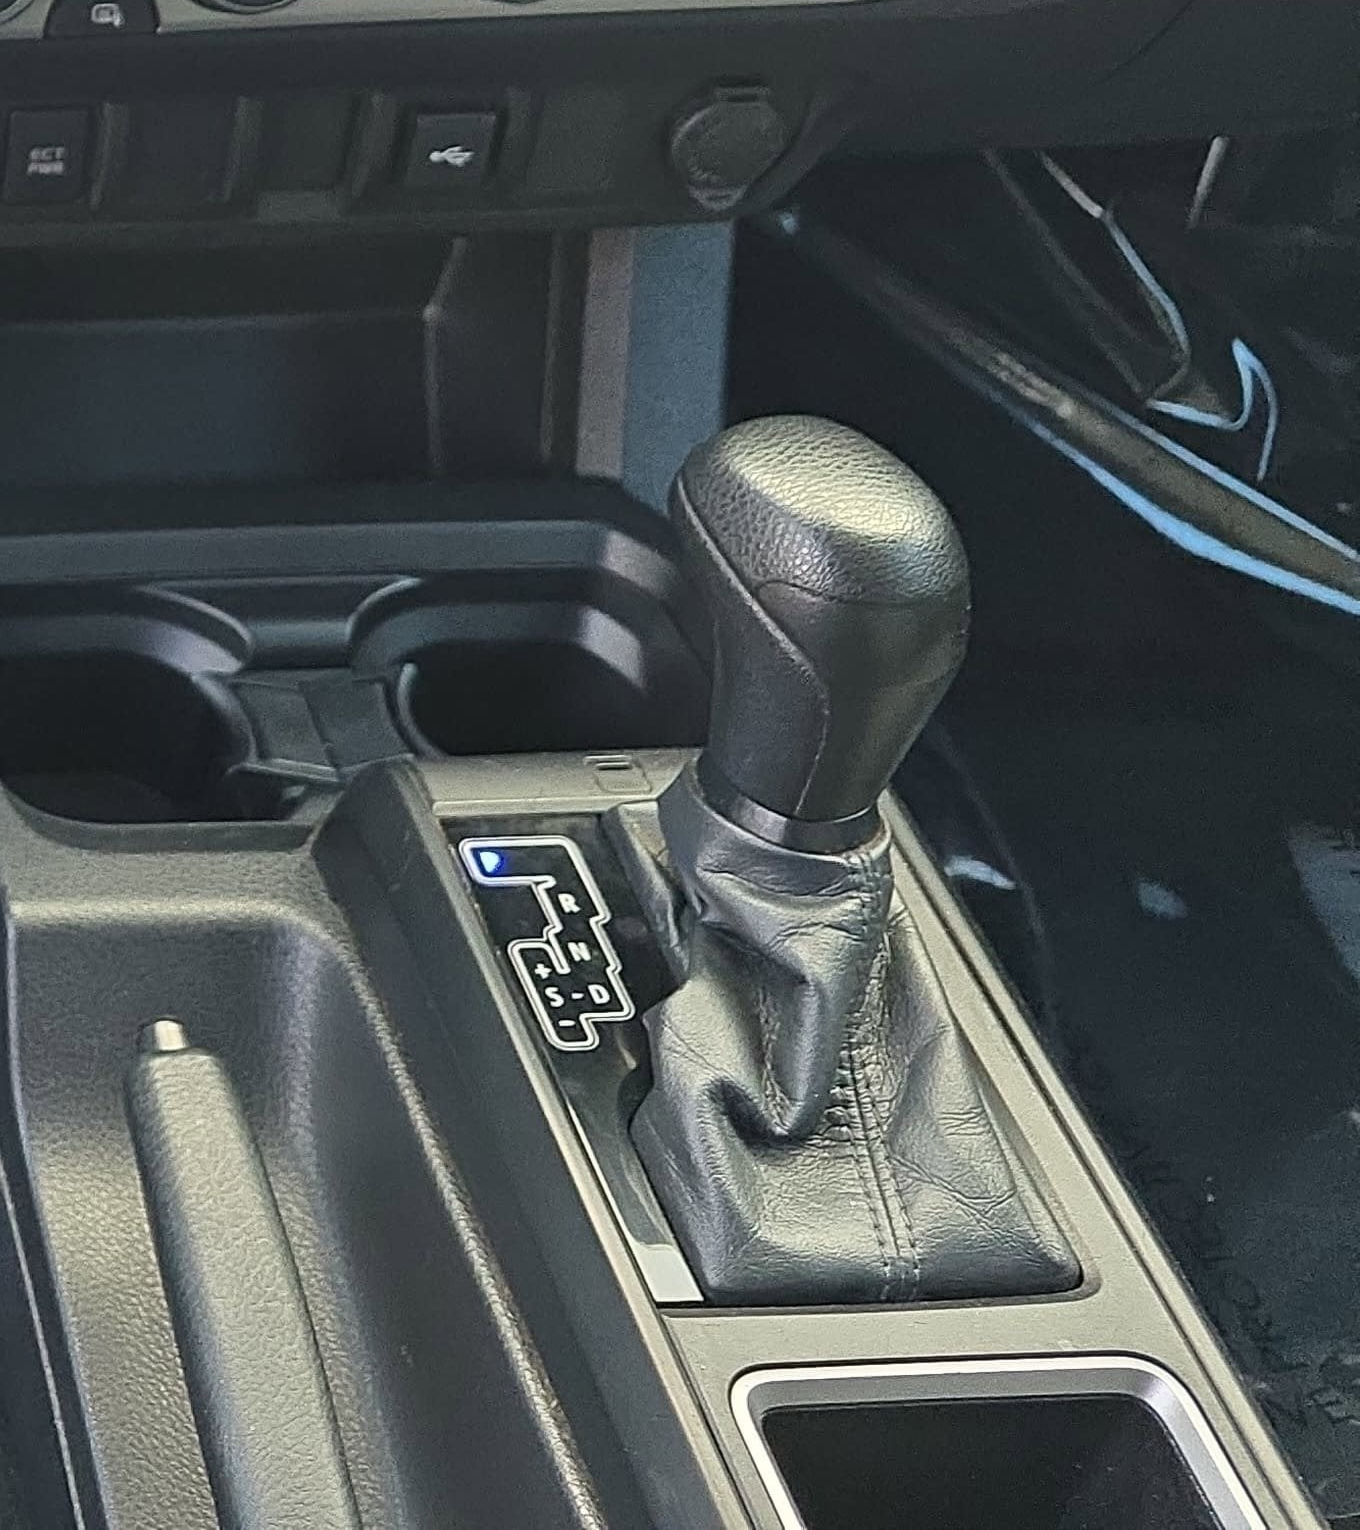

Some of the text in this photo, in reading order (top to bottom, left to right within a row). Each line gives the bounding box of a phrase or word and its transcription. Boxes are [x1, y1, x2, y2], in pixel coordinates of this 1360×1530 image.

[558, 893, 581, 914] R
[568, 942, 591, 962] N
[545, 985, 610, 1007] S D
